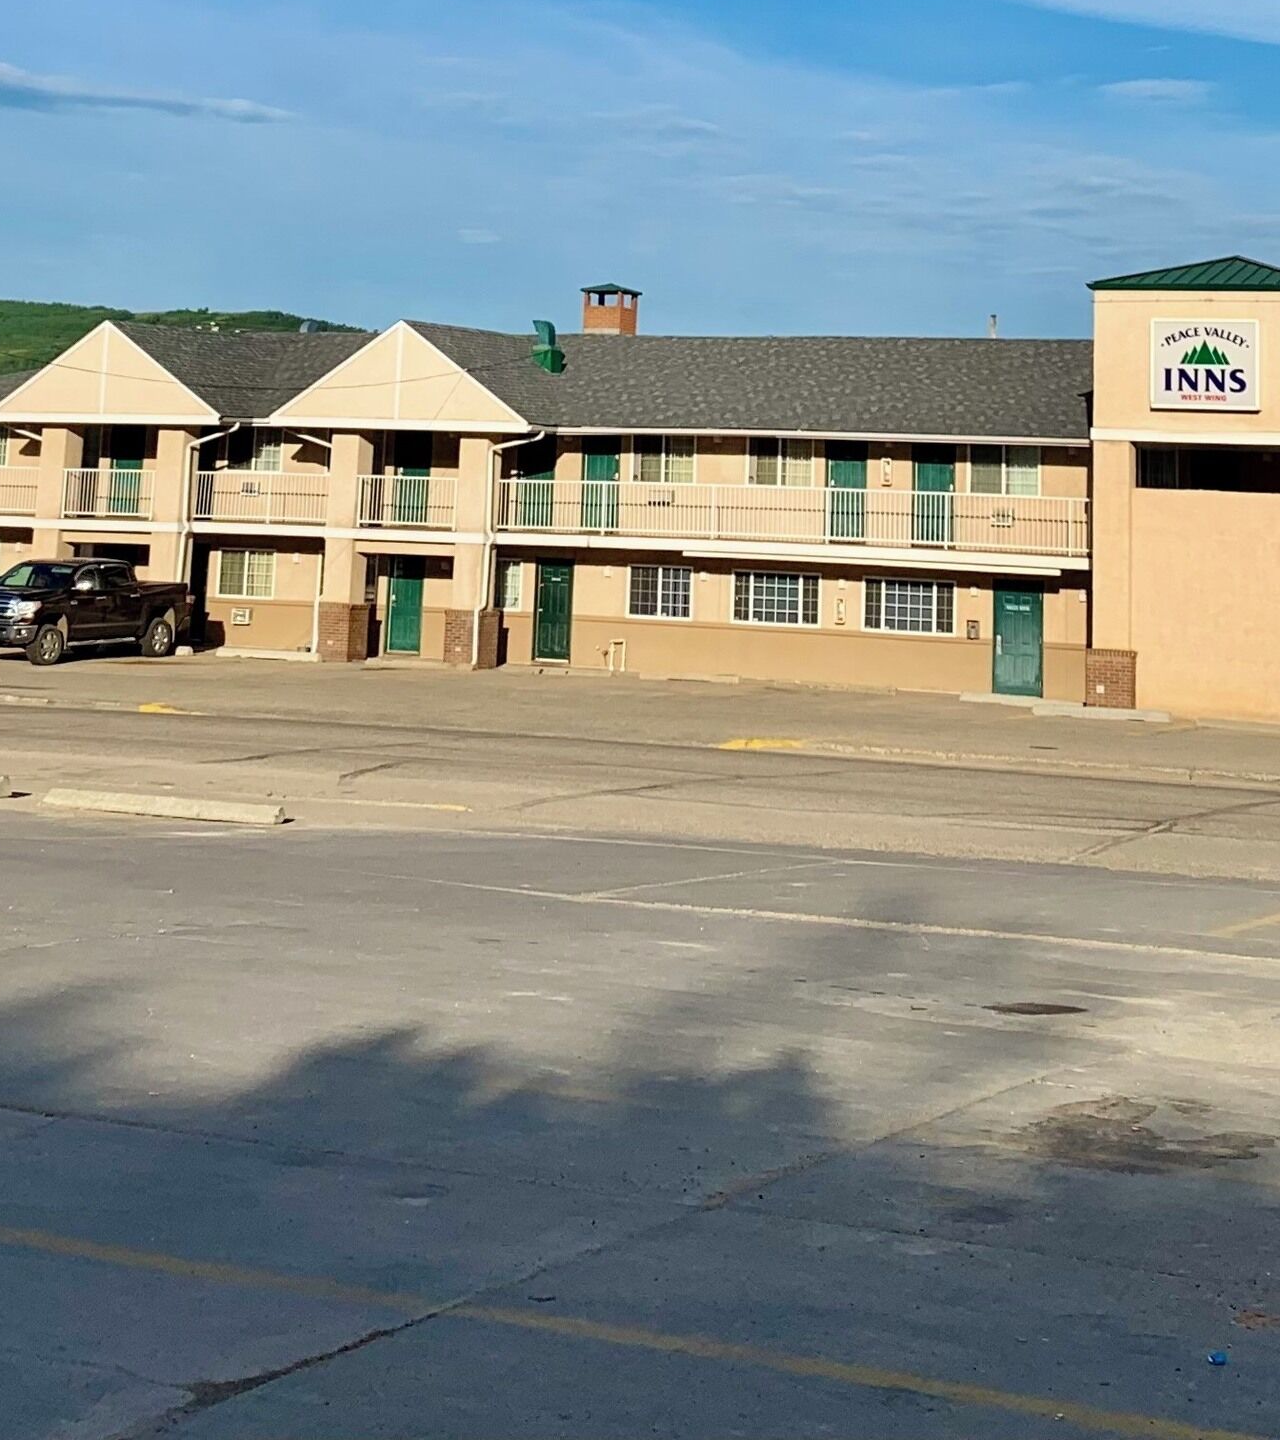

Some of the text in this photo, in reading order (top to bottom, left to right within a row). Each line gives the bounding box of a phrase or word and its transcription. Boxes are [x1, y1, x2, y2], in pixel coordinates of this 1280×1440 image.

[1164, 326, 1248, 348] PEACE VALLEY
[1164, 367, 1247, 393] INNS
[1205, 394, 1227, 402] WING
